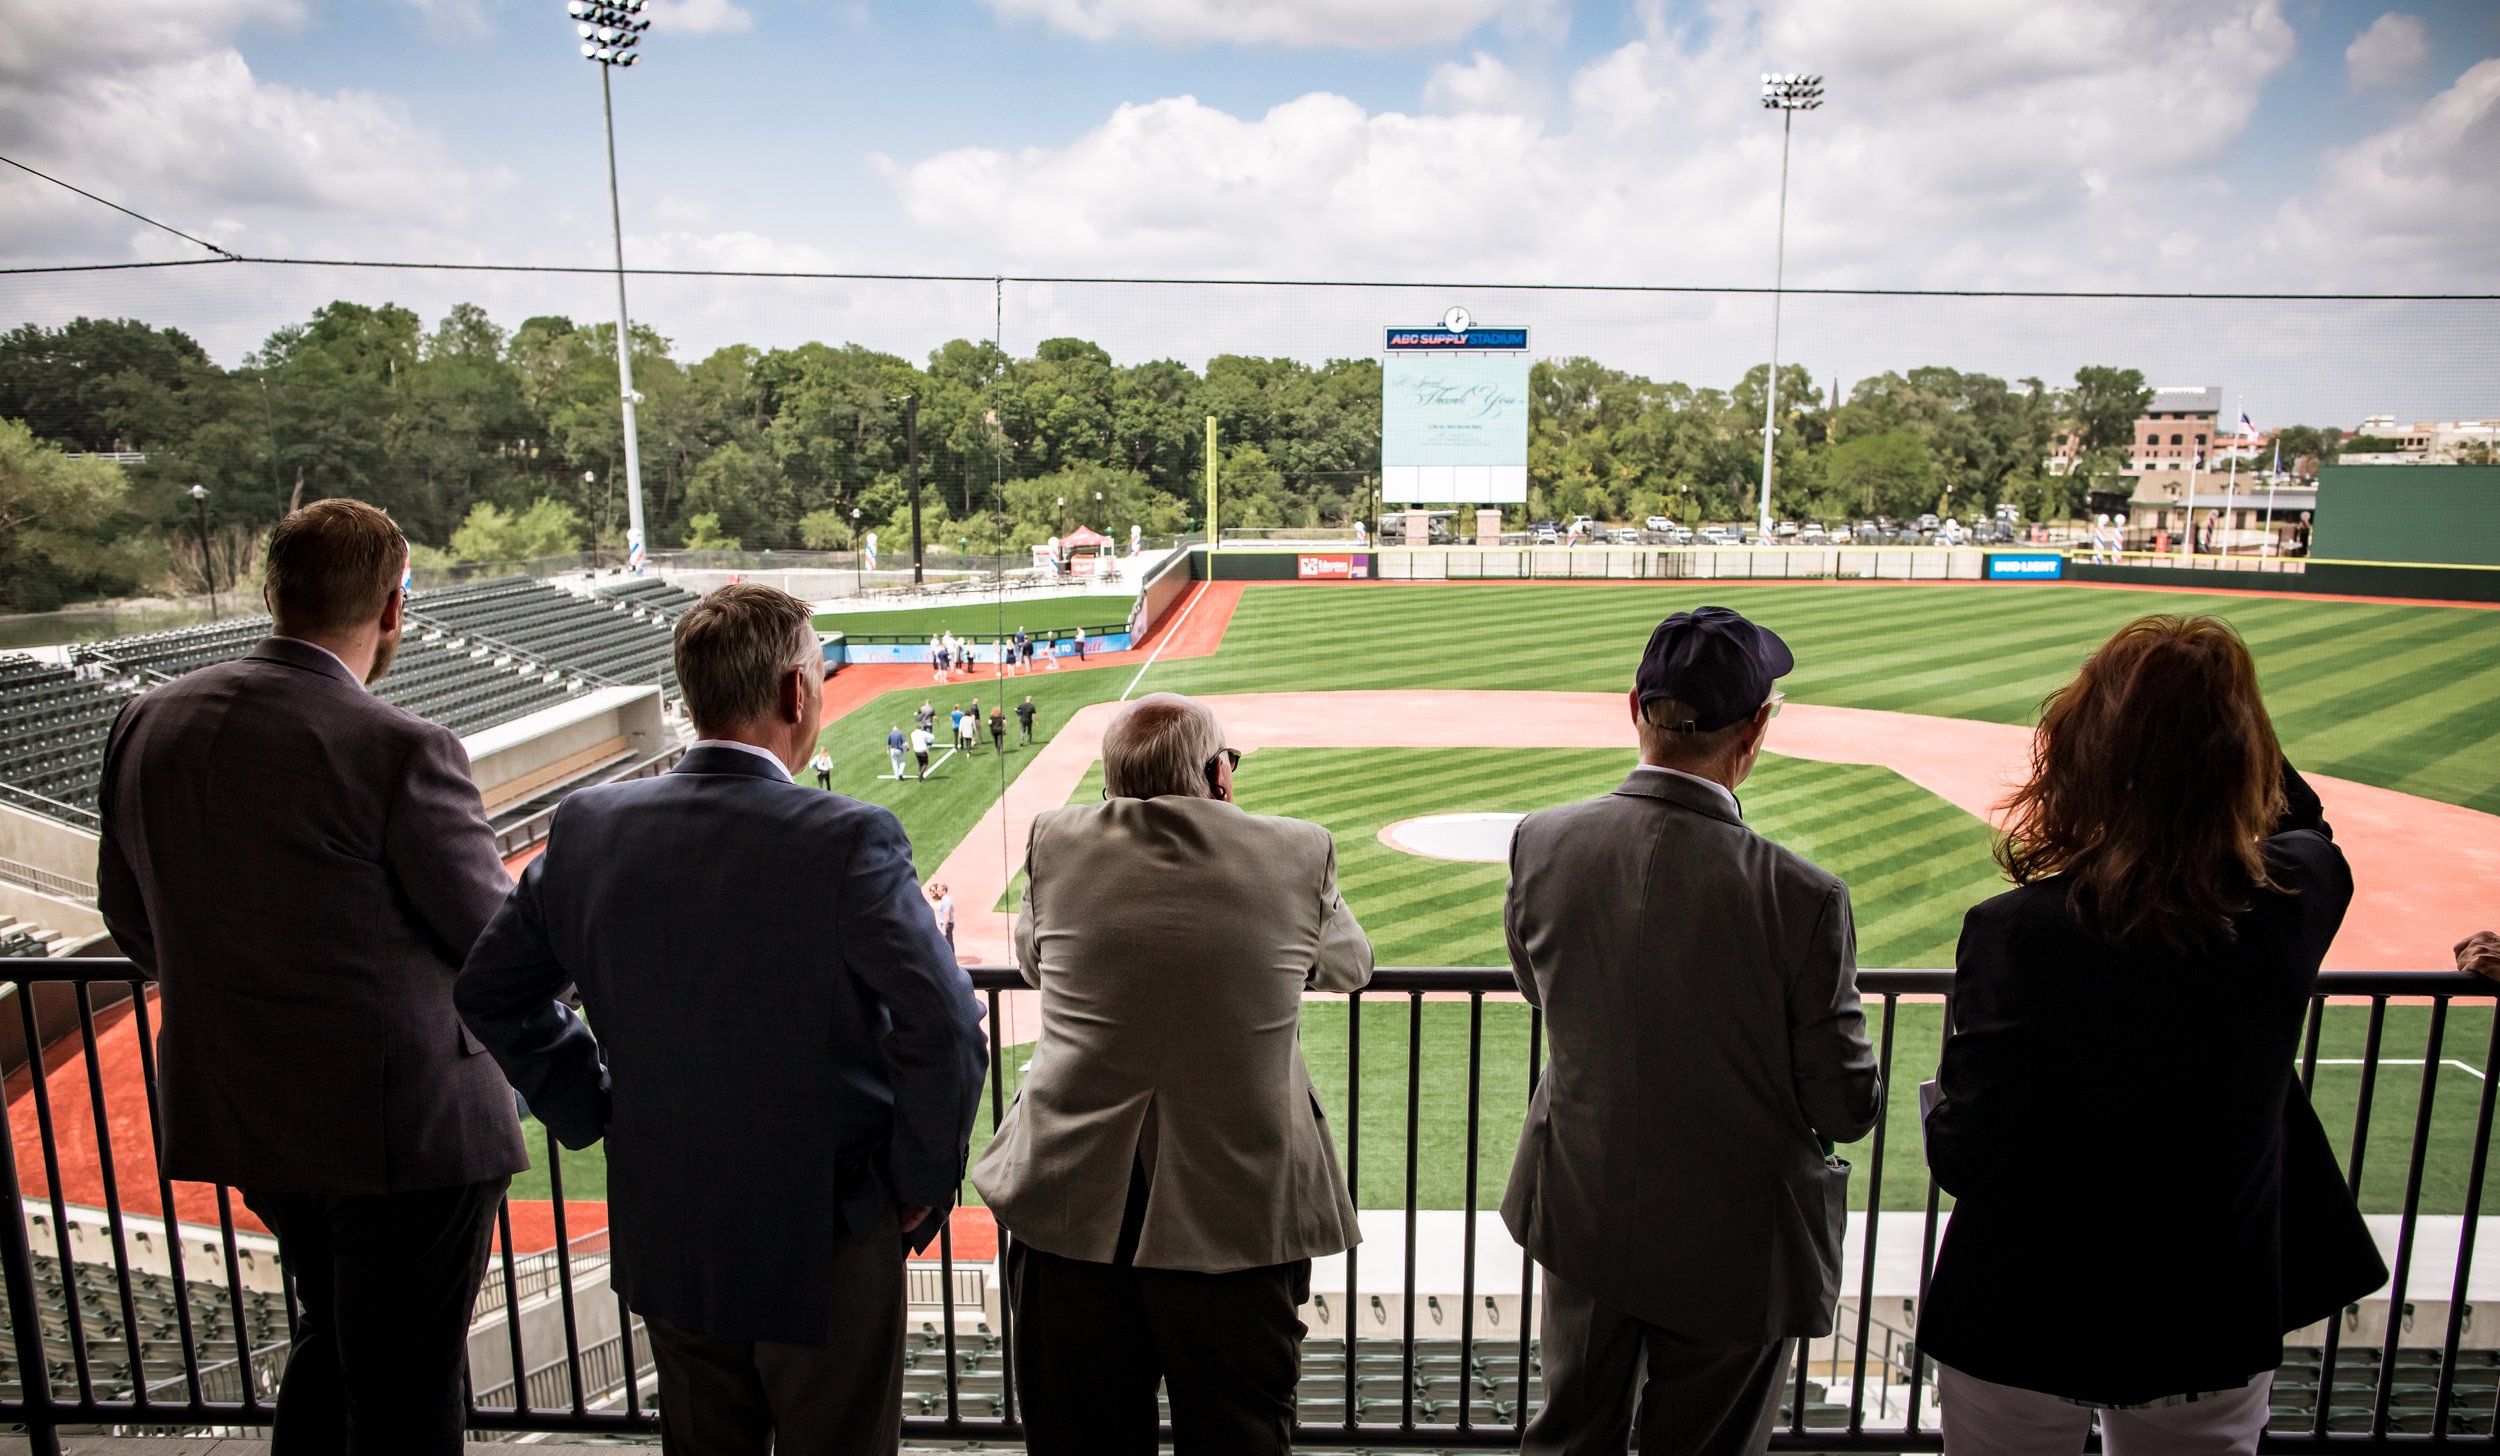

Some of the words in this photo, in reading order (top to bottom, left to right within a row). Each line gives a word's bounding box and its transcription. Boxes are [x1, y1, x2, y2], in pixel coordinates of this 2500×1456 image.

[1391, 334, 1419, 345] ABC
[1420, 334, 1468, 345] SUPPLY
[1469, 333, 1523, 345] STADIUM
[1410, 384, 1479, 406] Thank
[1994, 561, 2020, 572] BUD
[2021, 561, 2058, 572] LIGHT
